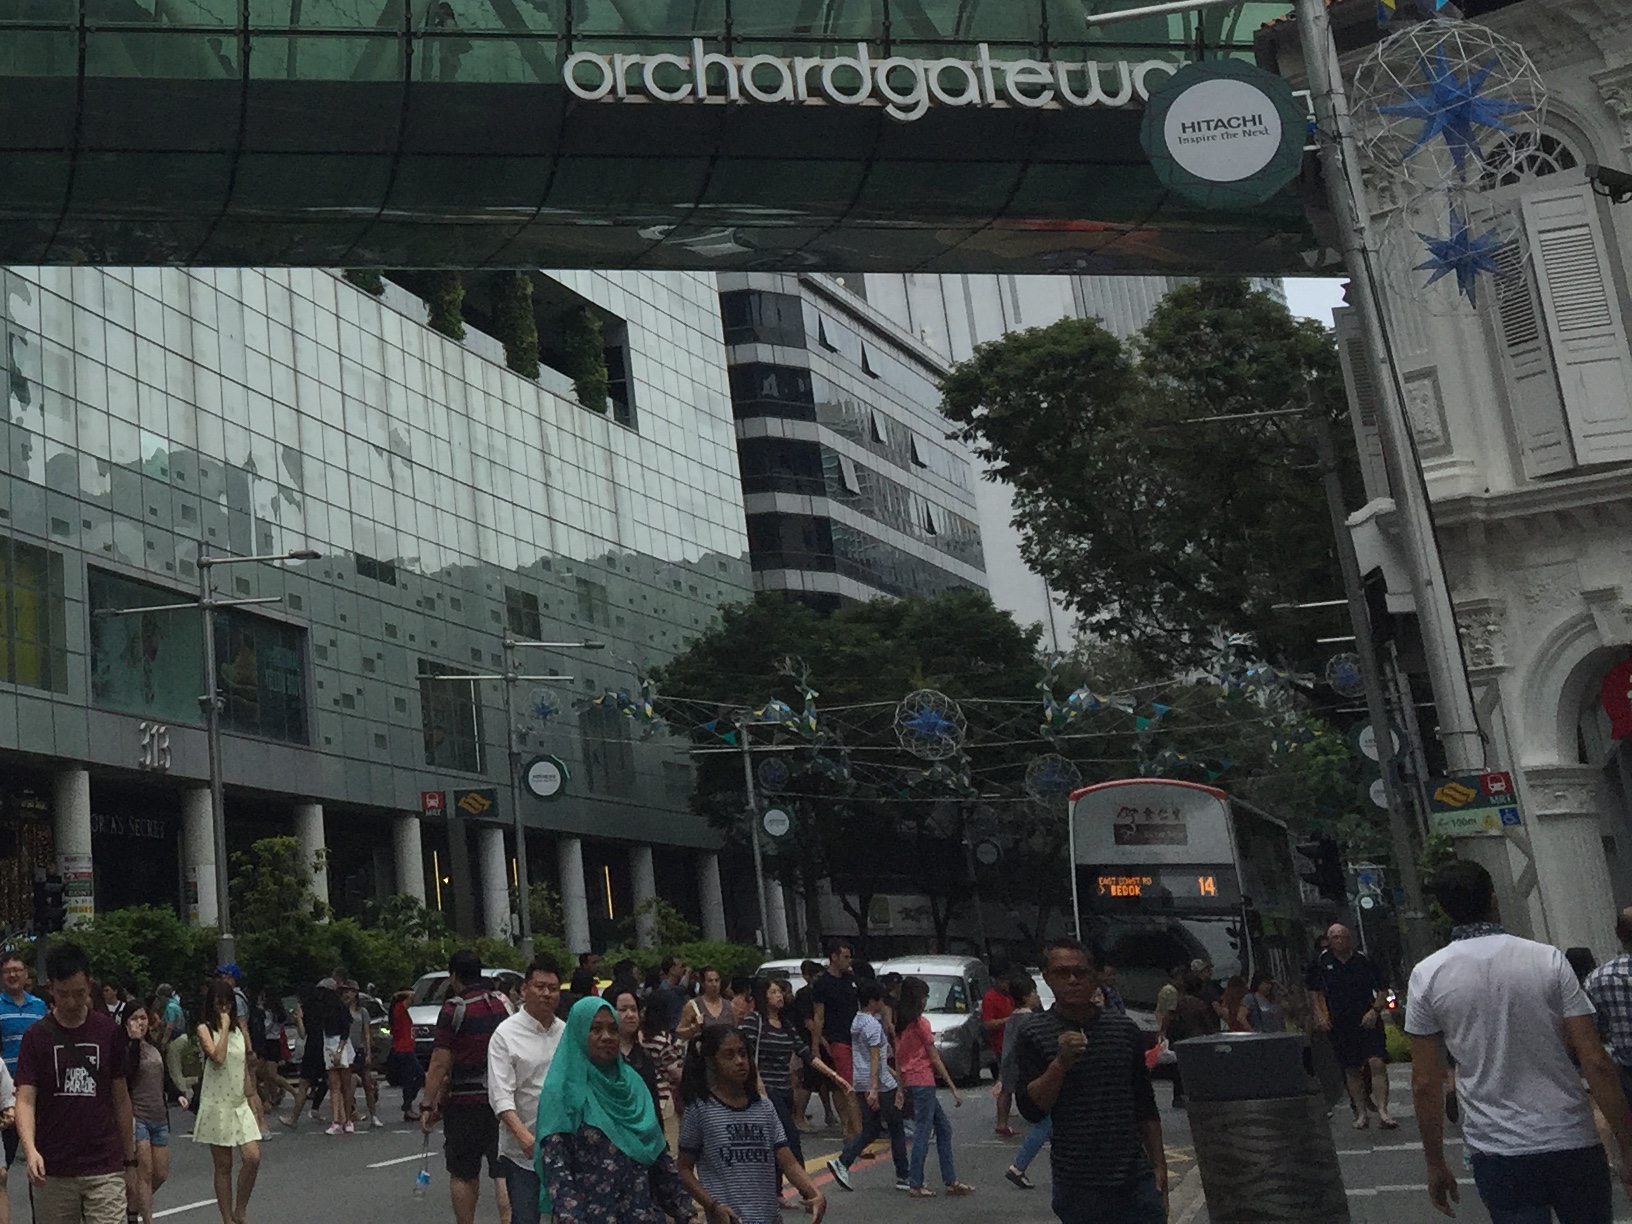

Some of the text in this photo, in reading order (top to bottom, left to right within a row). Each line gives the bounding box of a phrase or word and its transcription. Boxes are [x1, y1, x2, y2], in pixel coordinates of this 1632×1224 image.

[1181, 113, 1263, 134] HITACHI
[1178, 125, 1270, 145] Inspire the Next
[139, 722, 172, 769] 313
[1488, 795, 1513, 806] MRT
[1110, 885, 1142, 897] BEDOK
[1198, 876, 1216, 897] 14
